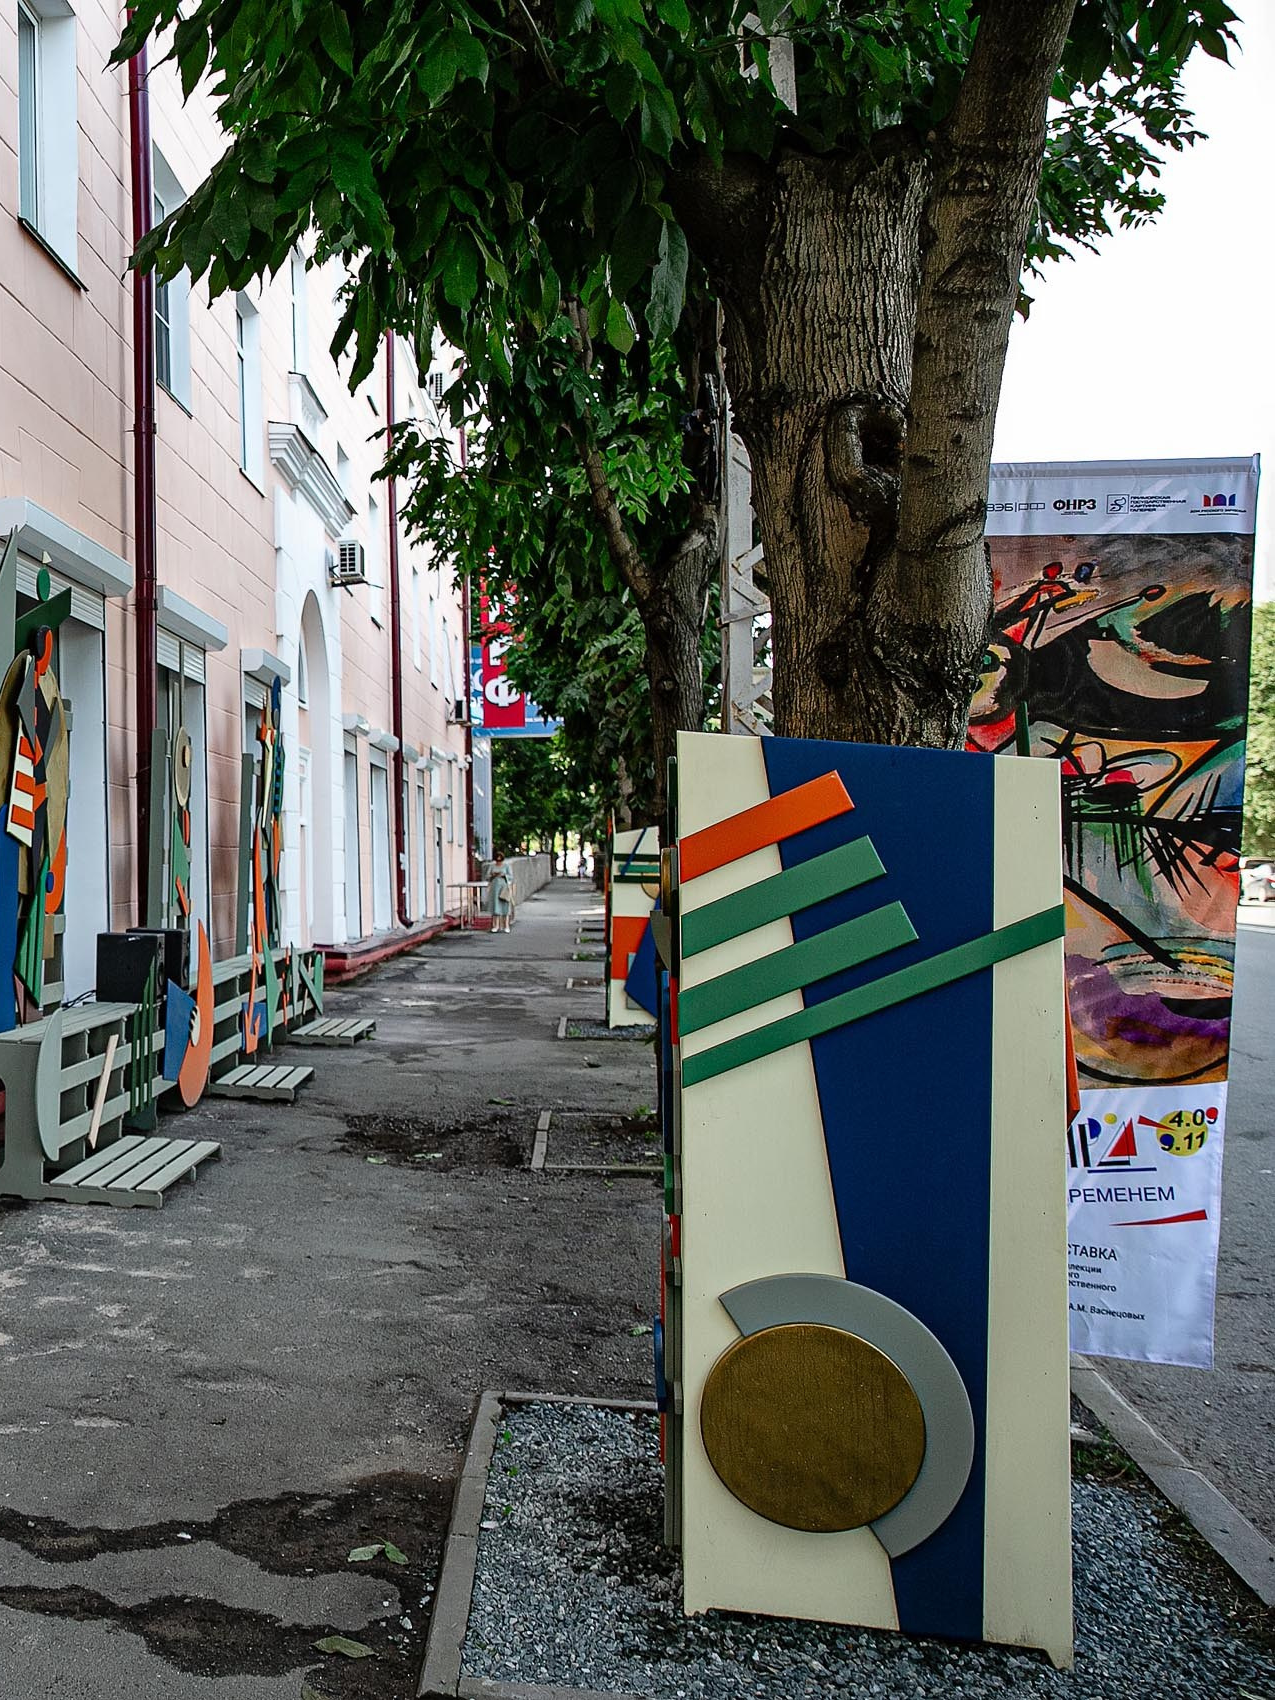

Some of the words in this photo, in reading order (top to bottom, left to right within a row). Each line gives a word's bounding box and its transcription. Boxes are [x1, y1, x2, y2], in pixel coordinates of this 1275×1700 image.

[1053, 499, 1097, 511] ФНРЗ
[1067, 1186, 1175, 1204] РЕМЕНЕМ
[1090, 1305, 1146, 1321] Васнецовых
